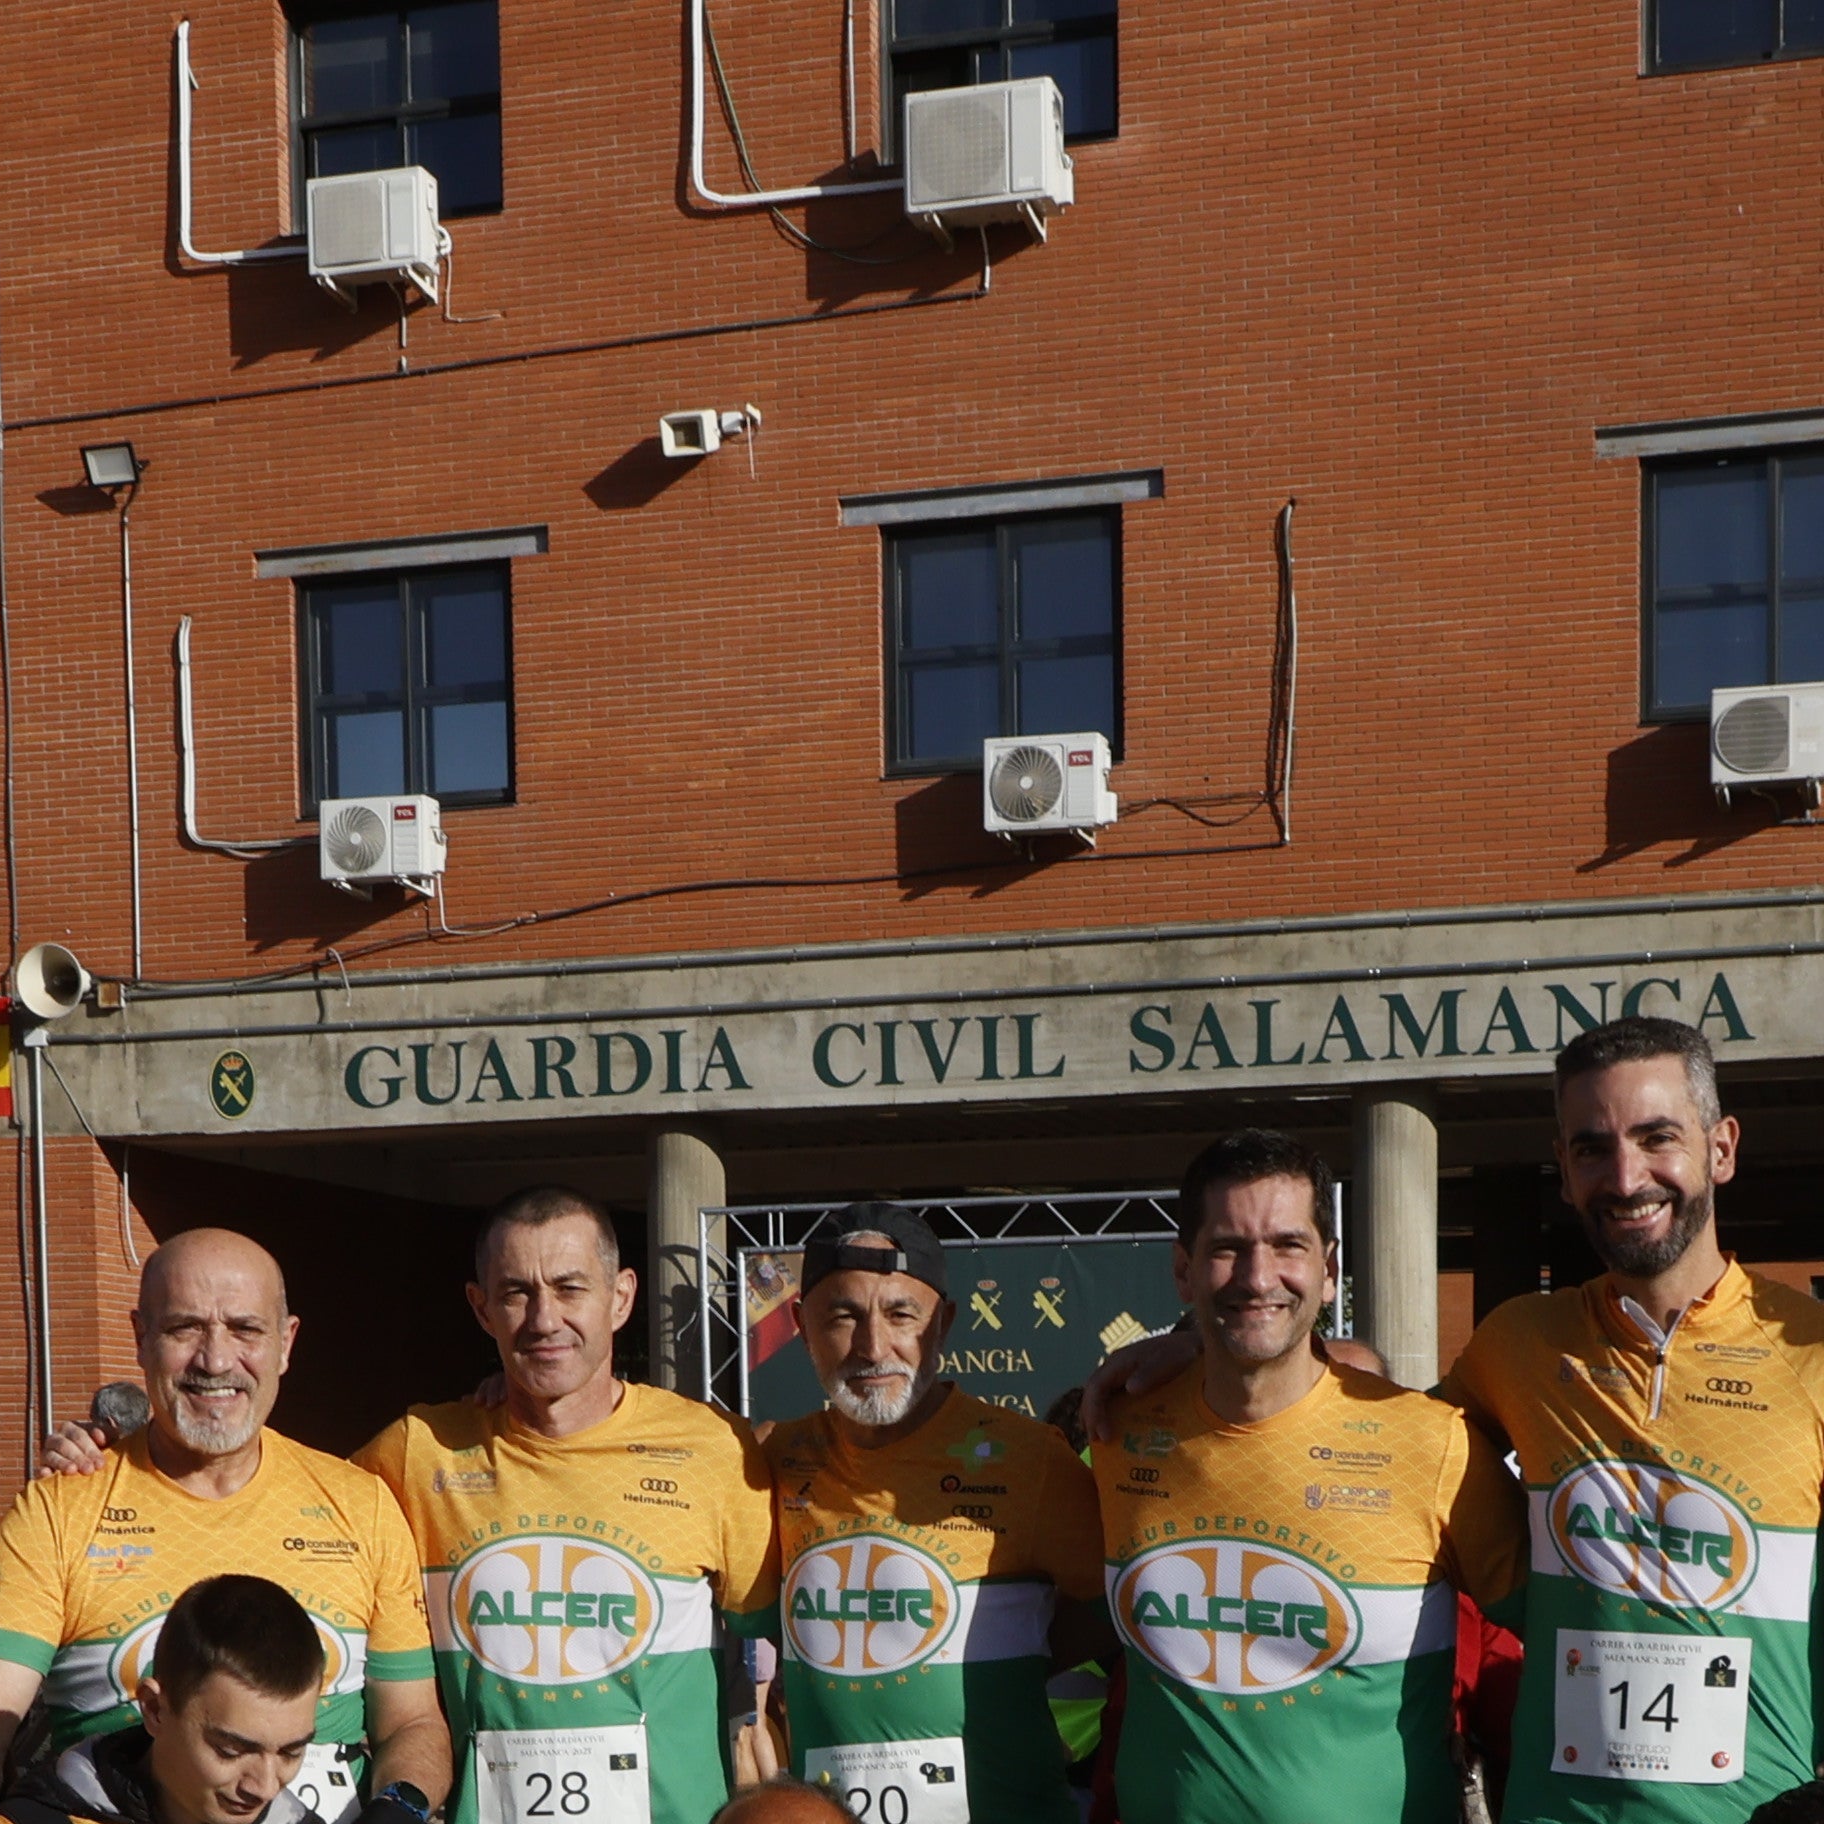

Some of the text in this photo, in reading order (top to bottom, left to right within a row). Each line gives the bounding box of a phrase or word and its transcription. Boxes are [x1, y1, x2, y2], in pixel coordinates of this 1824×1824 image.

[344, 1026, 752, 1108] GUARDIA
[813, 1012, 1065, 1088] CIVIL
[1684, 1392, 1769, 1411] Helmántica
[623, 1493, 690, 1511] Helmántica
[95, 1524, 155, 1536] elmántica
[305, 1538, 359, 1553] consulting
[448, 1514, 663, 1571] CLUB DEPORTIVO
[838, 1514, 962, 1566] DEPORTIVO
[933, 1521, 1006, 1535] Helmántica
[1117, 1515, 1357, 1579] CLUB DEPORTIVO
[1564, 1504, 1733, 1579] ALCER
[107, 1589, 174, 1637] CLUB
[468, 1590, 638, 1638] ALCER
[790, 1587, 935, 1630] ALCER
[1132, 1591, 1330, 1649] ALCER
[1609, 1680, 1679, 1733] 14
[525, 1771, 591, 1817] 28
